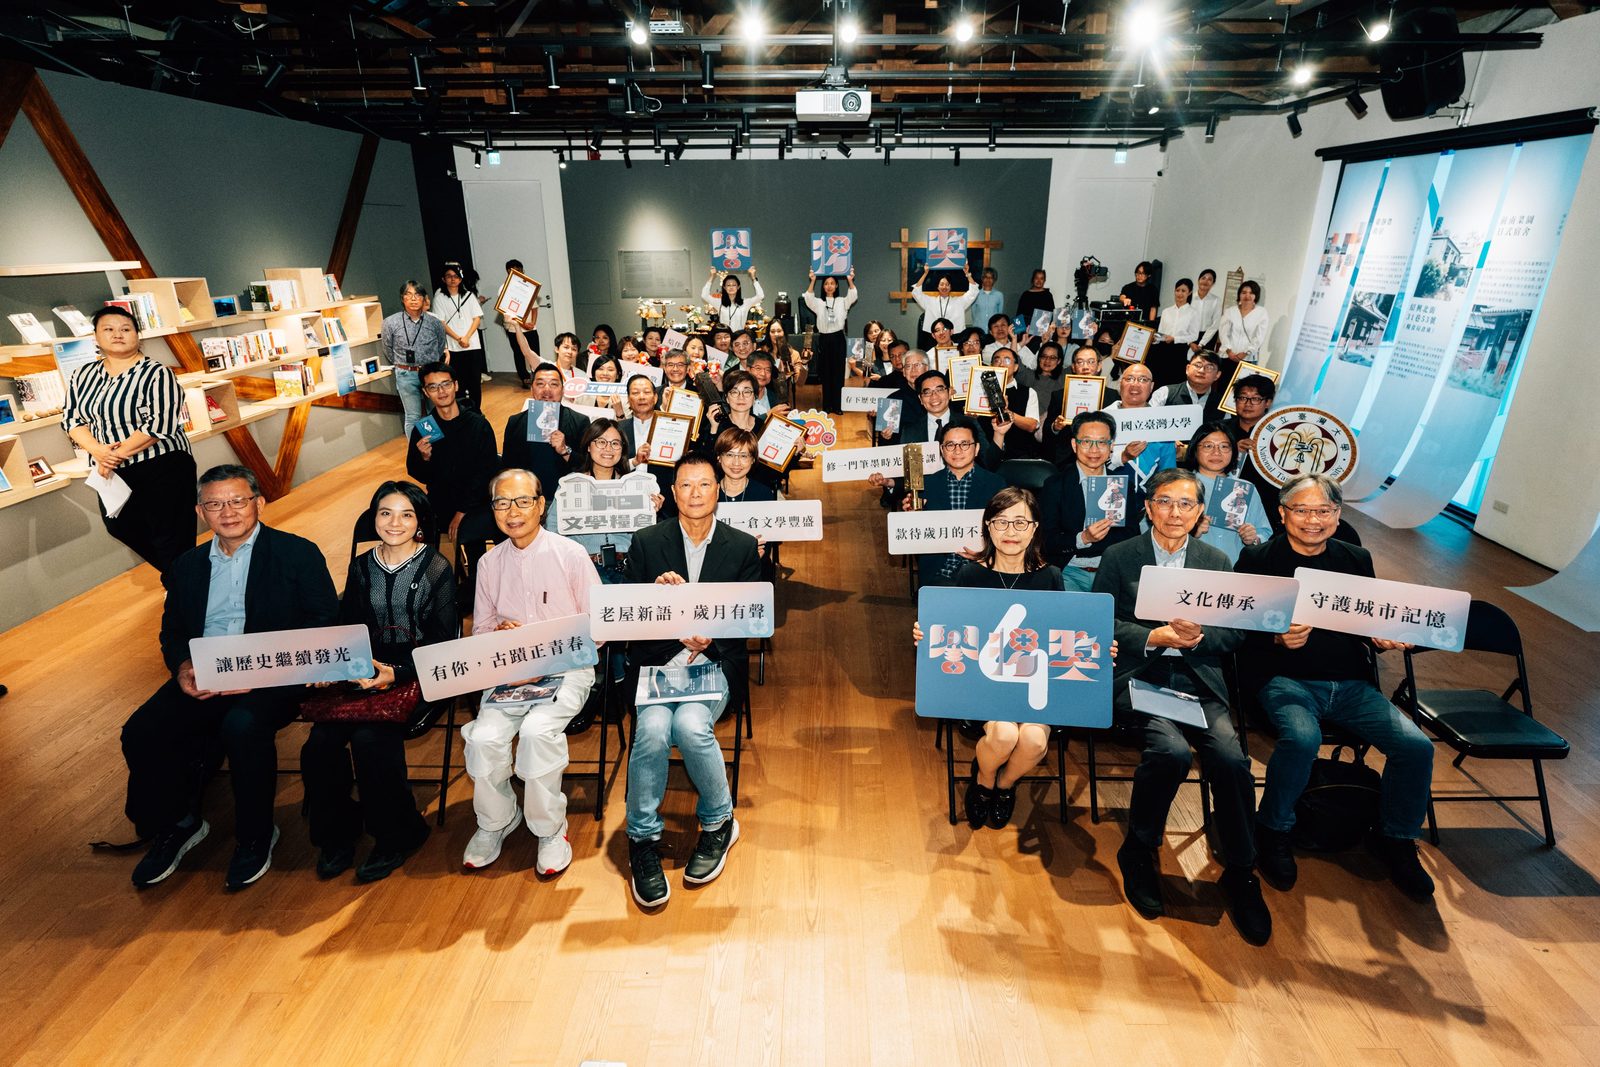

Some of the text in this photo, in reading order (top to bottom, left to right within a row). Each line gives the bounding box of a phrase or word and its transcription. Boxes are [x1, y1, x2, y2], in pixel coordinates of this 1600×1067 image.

[564, 383, 586, 392] GO
[1121, 417, 1192, 432] 國立臺灣大學
[826, 453, 936, 472] 修一門筆墨時光課
[1259, 445, 1274, 473] National
[895, 525, 982, 540] 款待歲月的不
[1176, 589, 1256, 612] 文化傳承
[1310, 591, 1447, 629] 守護城市記憶
[599, 604, 765, 623] 老屋新語，歲月有聲
[215, 646, 352, 674] 讓歷史繼續發光
[430, 635, 584, 683] 有你，古蹟正青春
[978, 603, 1048, 711] 4
